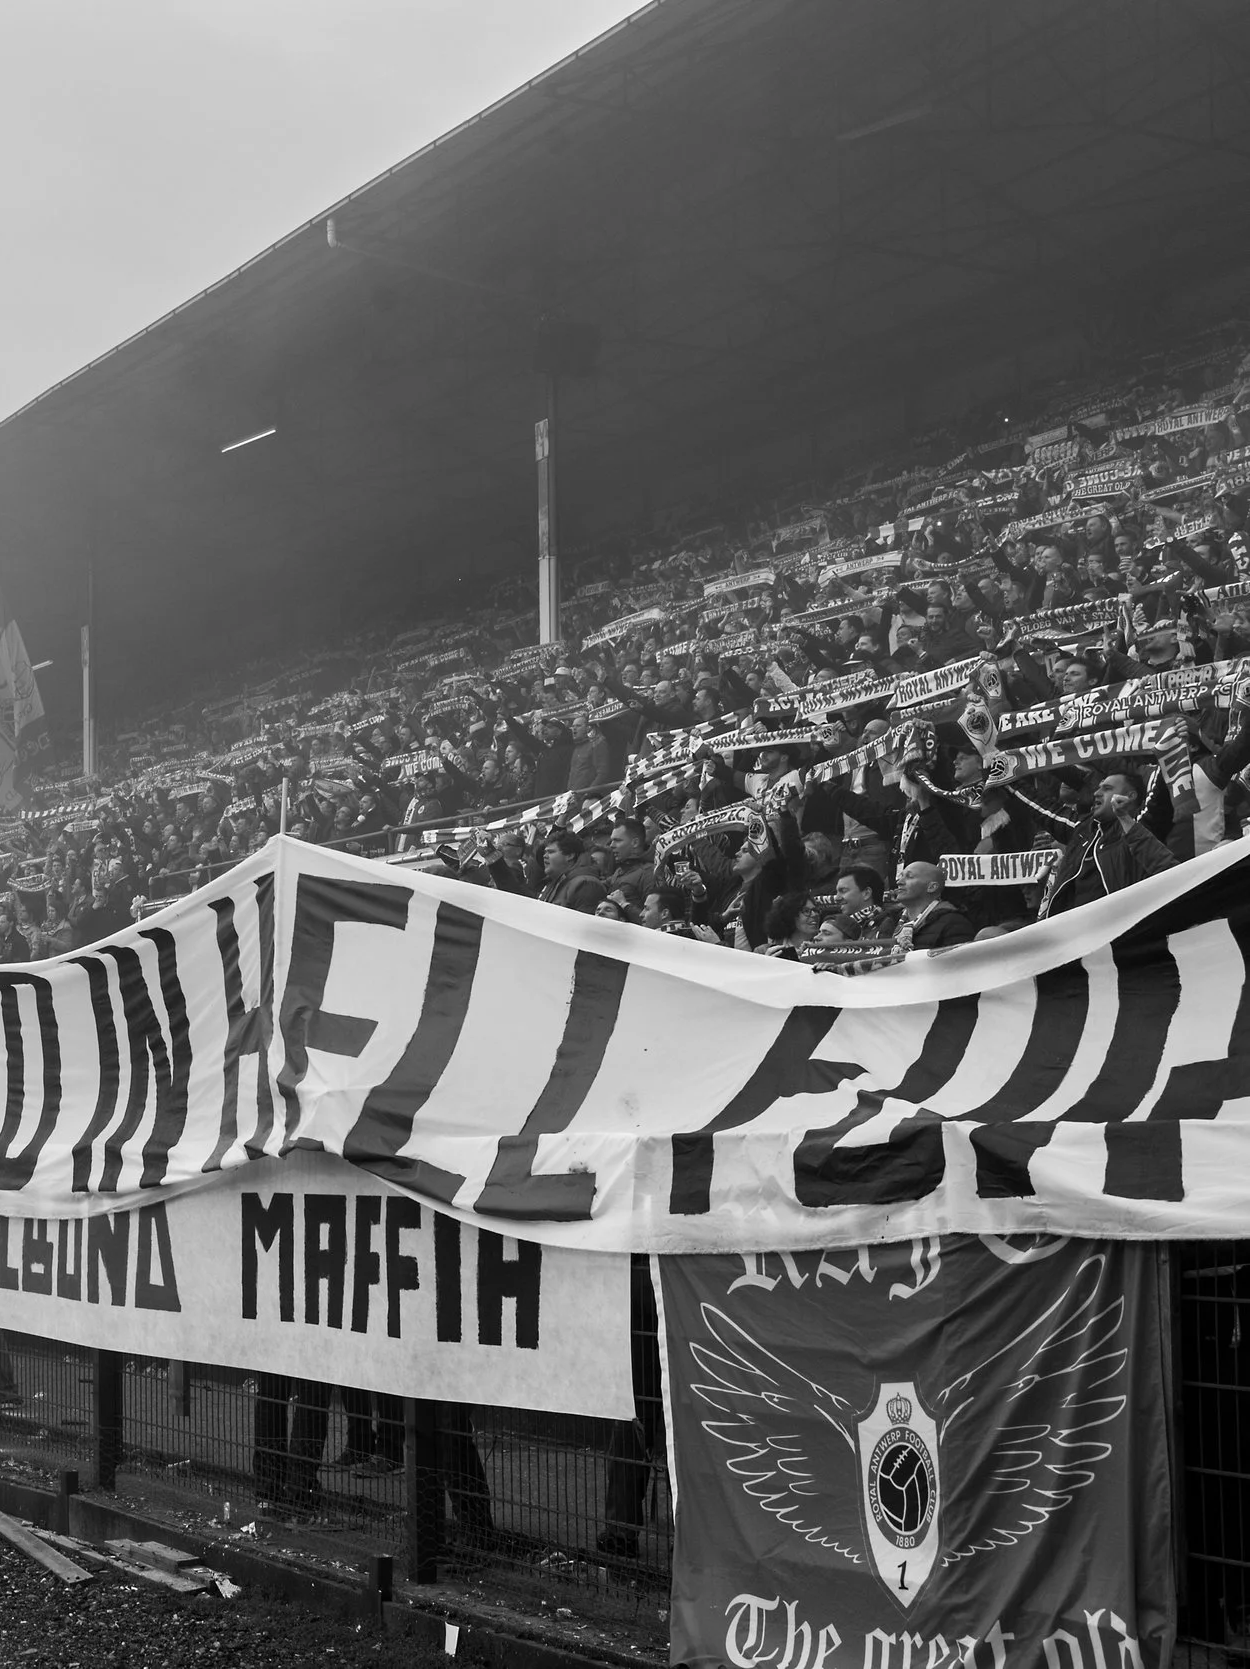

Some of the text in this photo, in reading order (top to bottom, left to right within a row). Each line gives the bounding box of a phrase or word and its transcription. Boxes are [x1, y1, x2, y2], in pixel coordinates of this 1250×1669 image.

[1020, 619, 1052, 634] PLOEG
[1055, 615, 1076, 625] VAN
[899, 675, 933, 704] ROYAL
[1167, 664, 1213, 688] PARMA
[767, 694, 800, 712] ACT
[1082, 695, 1130, 717] ROYAL
[1133, 685, 1208, 708] ANTWERP
[1211, 682, 1232, 696] FC
[1019, 739, 1065, 770] WE
[1072, 719, 1163, 759] COME
[404, 761, 419, 776] WE
[659, 837, 671, 849] R.
[671, 812, 727, 842] ANTWERP
[57, 928, 192, 1193] IN
[241, 1192, 543, 1350] MAFFIA
[869, 1430, 936, 1524] ROYAL ANTWERP FOOTBALL CLUB
[895, 1535, 916, 1548] 1880
[897, 1560, 910, 1591] 1
[724, 1592, 843, 1669] The
